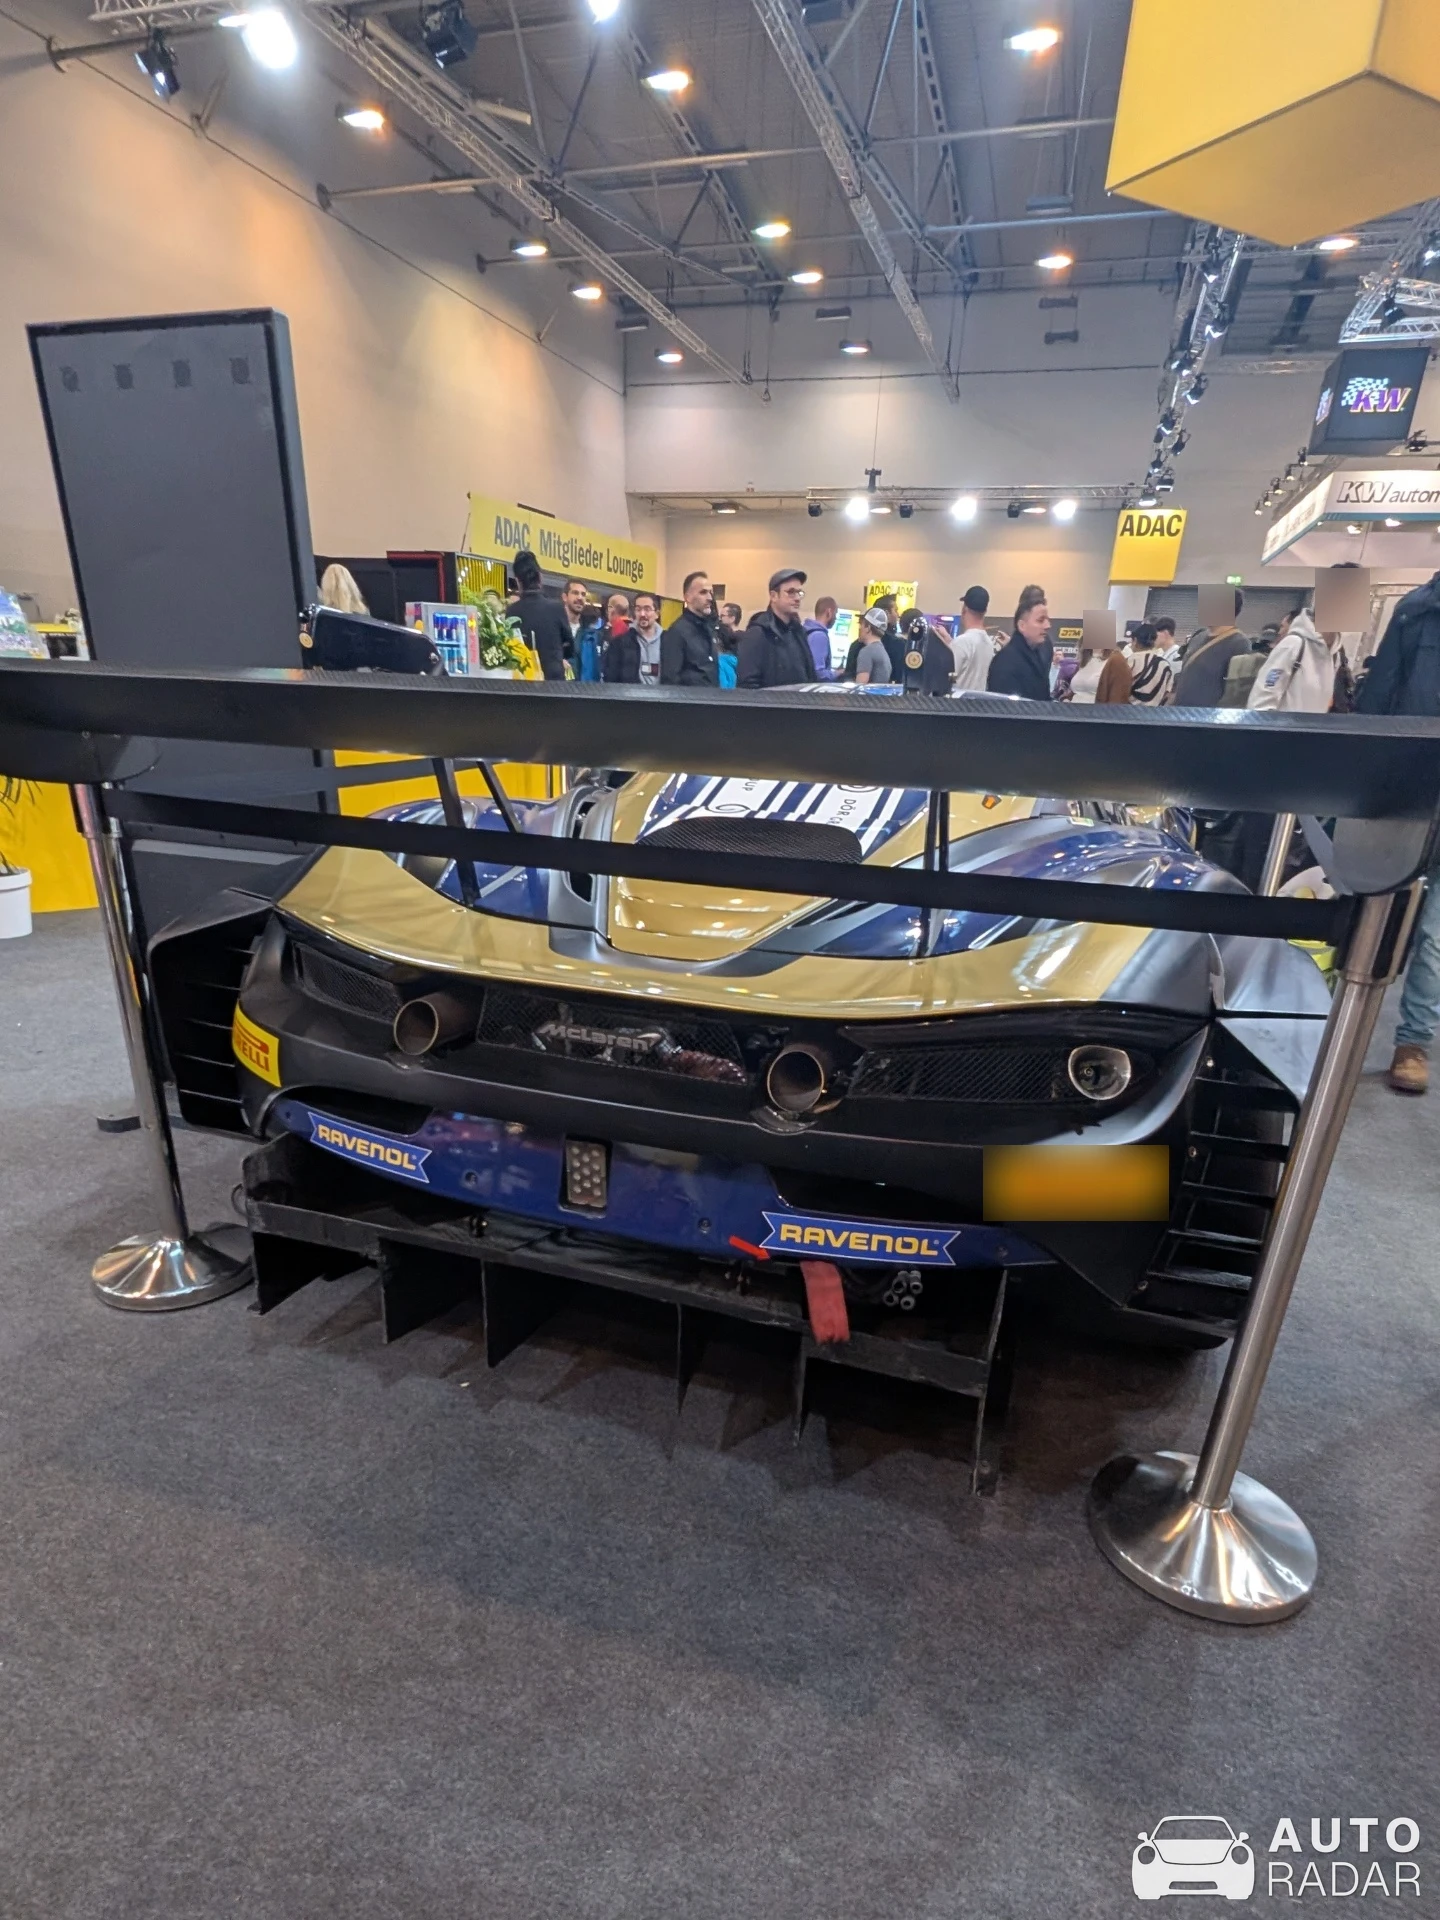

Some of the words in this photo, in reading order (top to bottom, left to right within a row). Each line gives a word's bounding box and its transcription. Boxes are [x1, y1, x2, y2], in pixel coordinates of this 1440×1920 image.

[1349, 387, 1412, 413] KW
[1336, 481, 1394, 503] KW
[1119, 514, 1183, 537] ADAC
[494, 515, 531, 550] ADAC
[539, 528, 604, 568] Mitglieder
[606, 548, 644, 583] Lounge
[869, 585, 891, 597] ADAC
[897, 587, 915, 598] ADAC
[537, 1023, 649, 1051] McLaren
